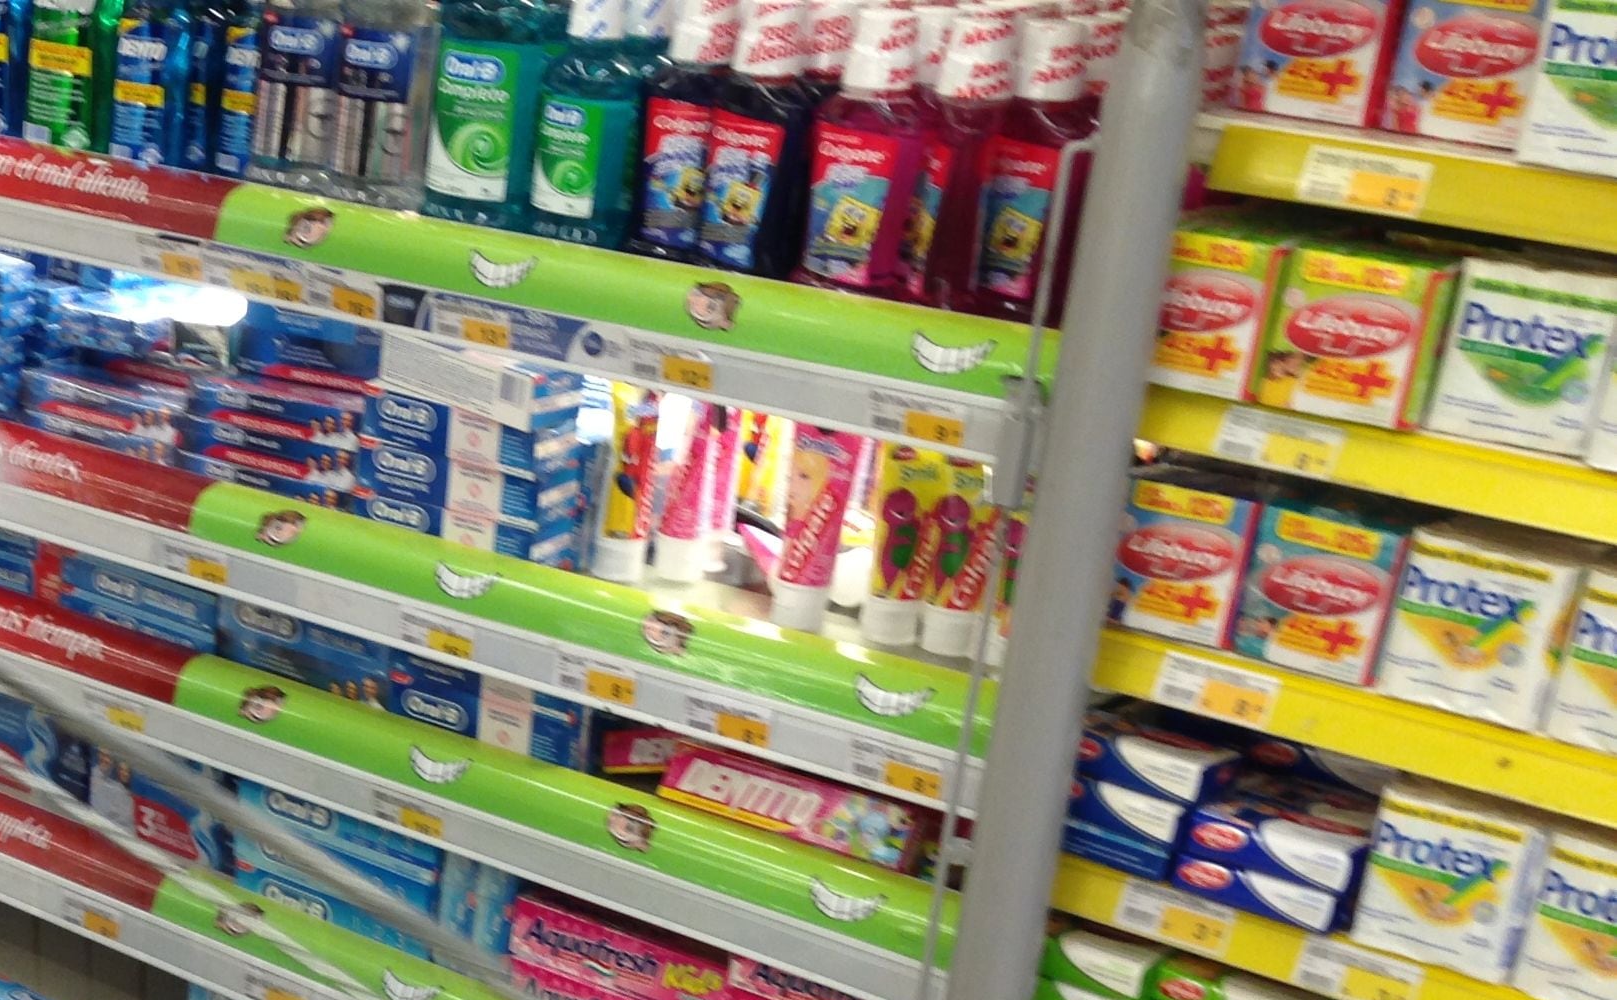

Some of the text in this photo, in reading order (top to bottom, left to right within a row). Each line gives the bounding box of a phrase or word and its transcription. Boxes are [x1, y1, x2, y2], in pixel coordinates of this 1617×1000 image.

[1460, 301, 1590, 361] Protex
[1400, 563, 1529, 622] Protex
[1378, 818, 1502, 884] Protex
[526, 919, 658, 976] Aquafresh
